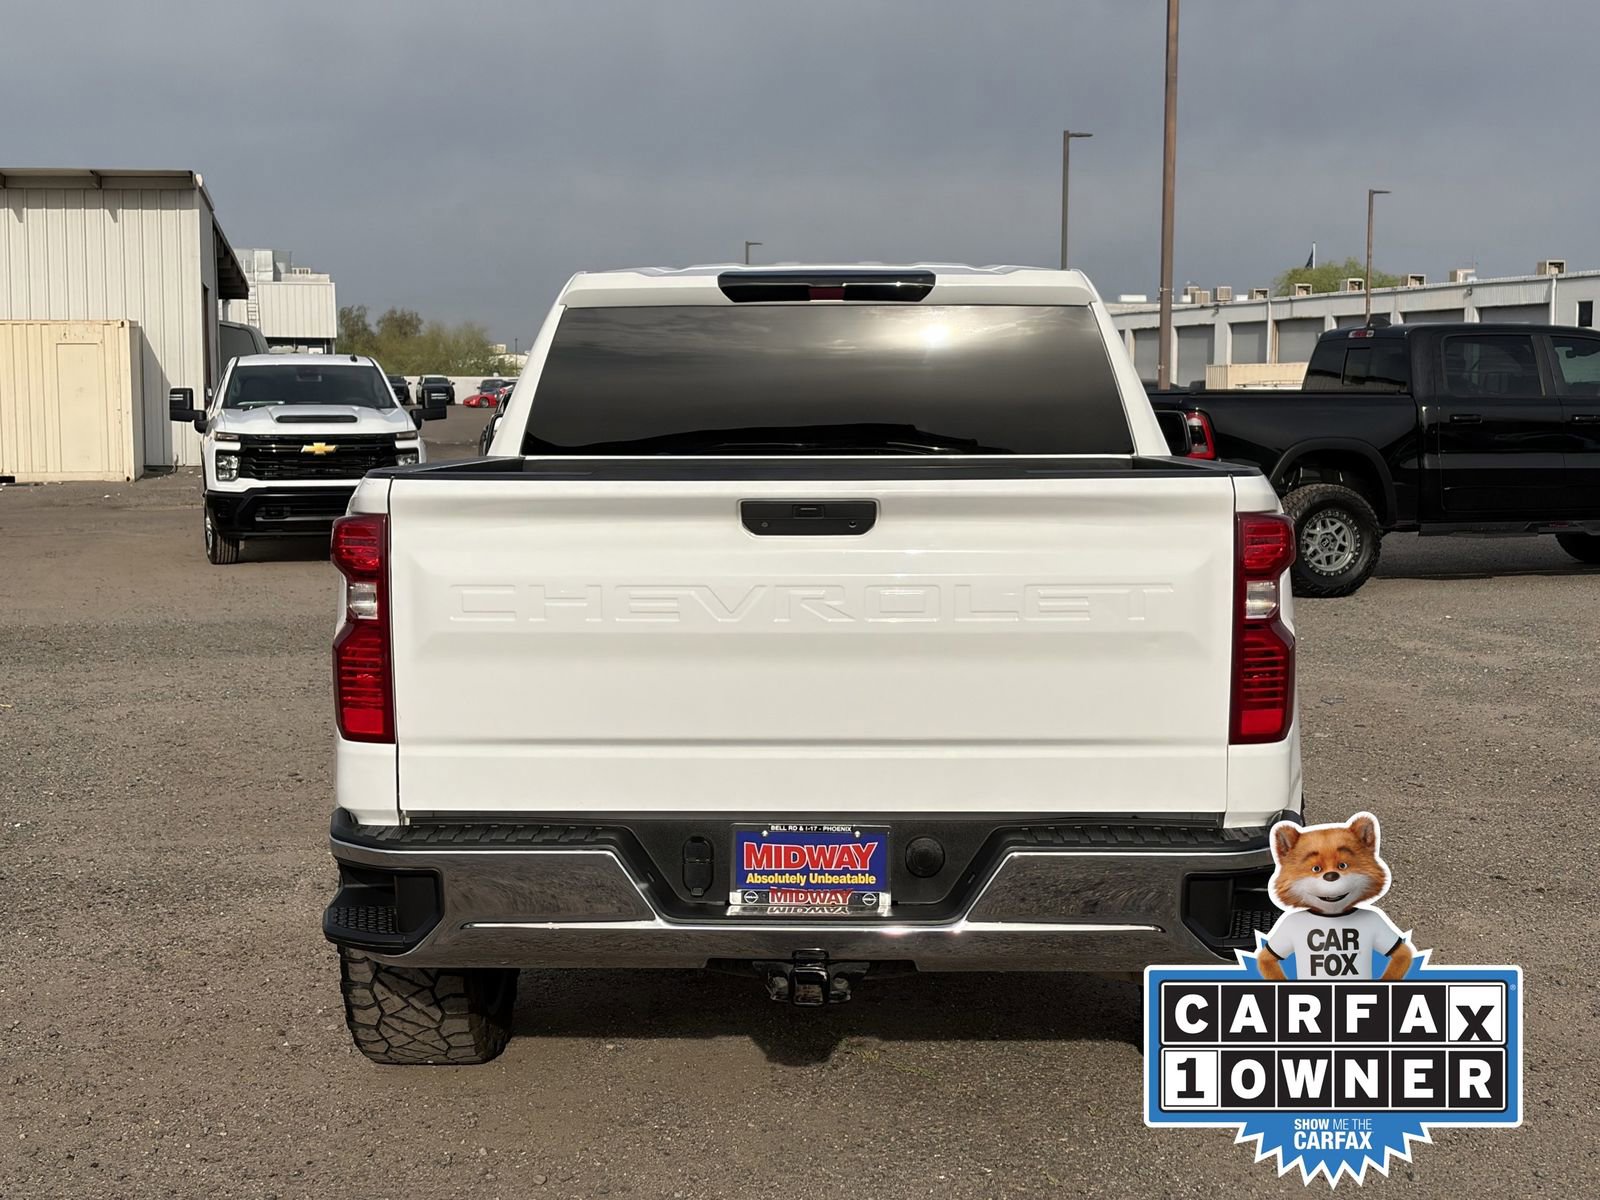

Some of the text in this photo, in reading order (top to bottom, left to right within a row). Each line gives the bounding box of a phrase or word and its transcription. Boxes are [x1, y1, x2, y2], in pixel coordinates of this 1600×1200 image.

[449, 583, 1174, 623] CHEVROLET
[744, 842, 878, 870] MIDWAY
[746, 873, 876, 886] Absolutely Unbeatable
[768, 887, 854, 905] MIDWAY
